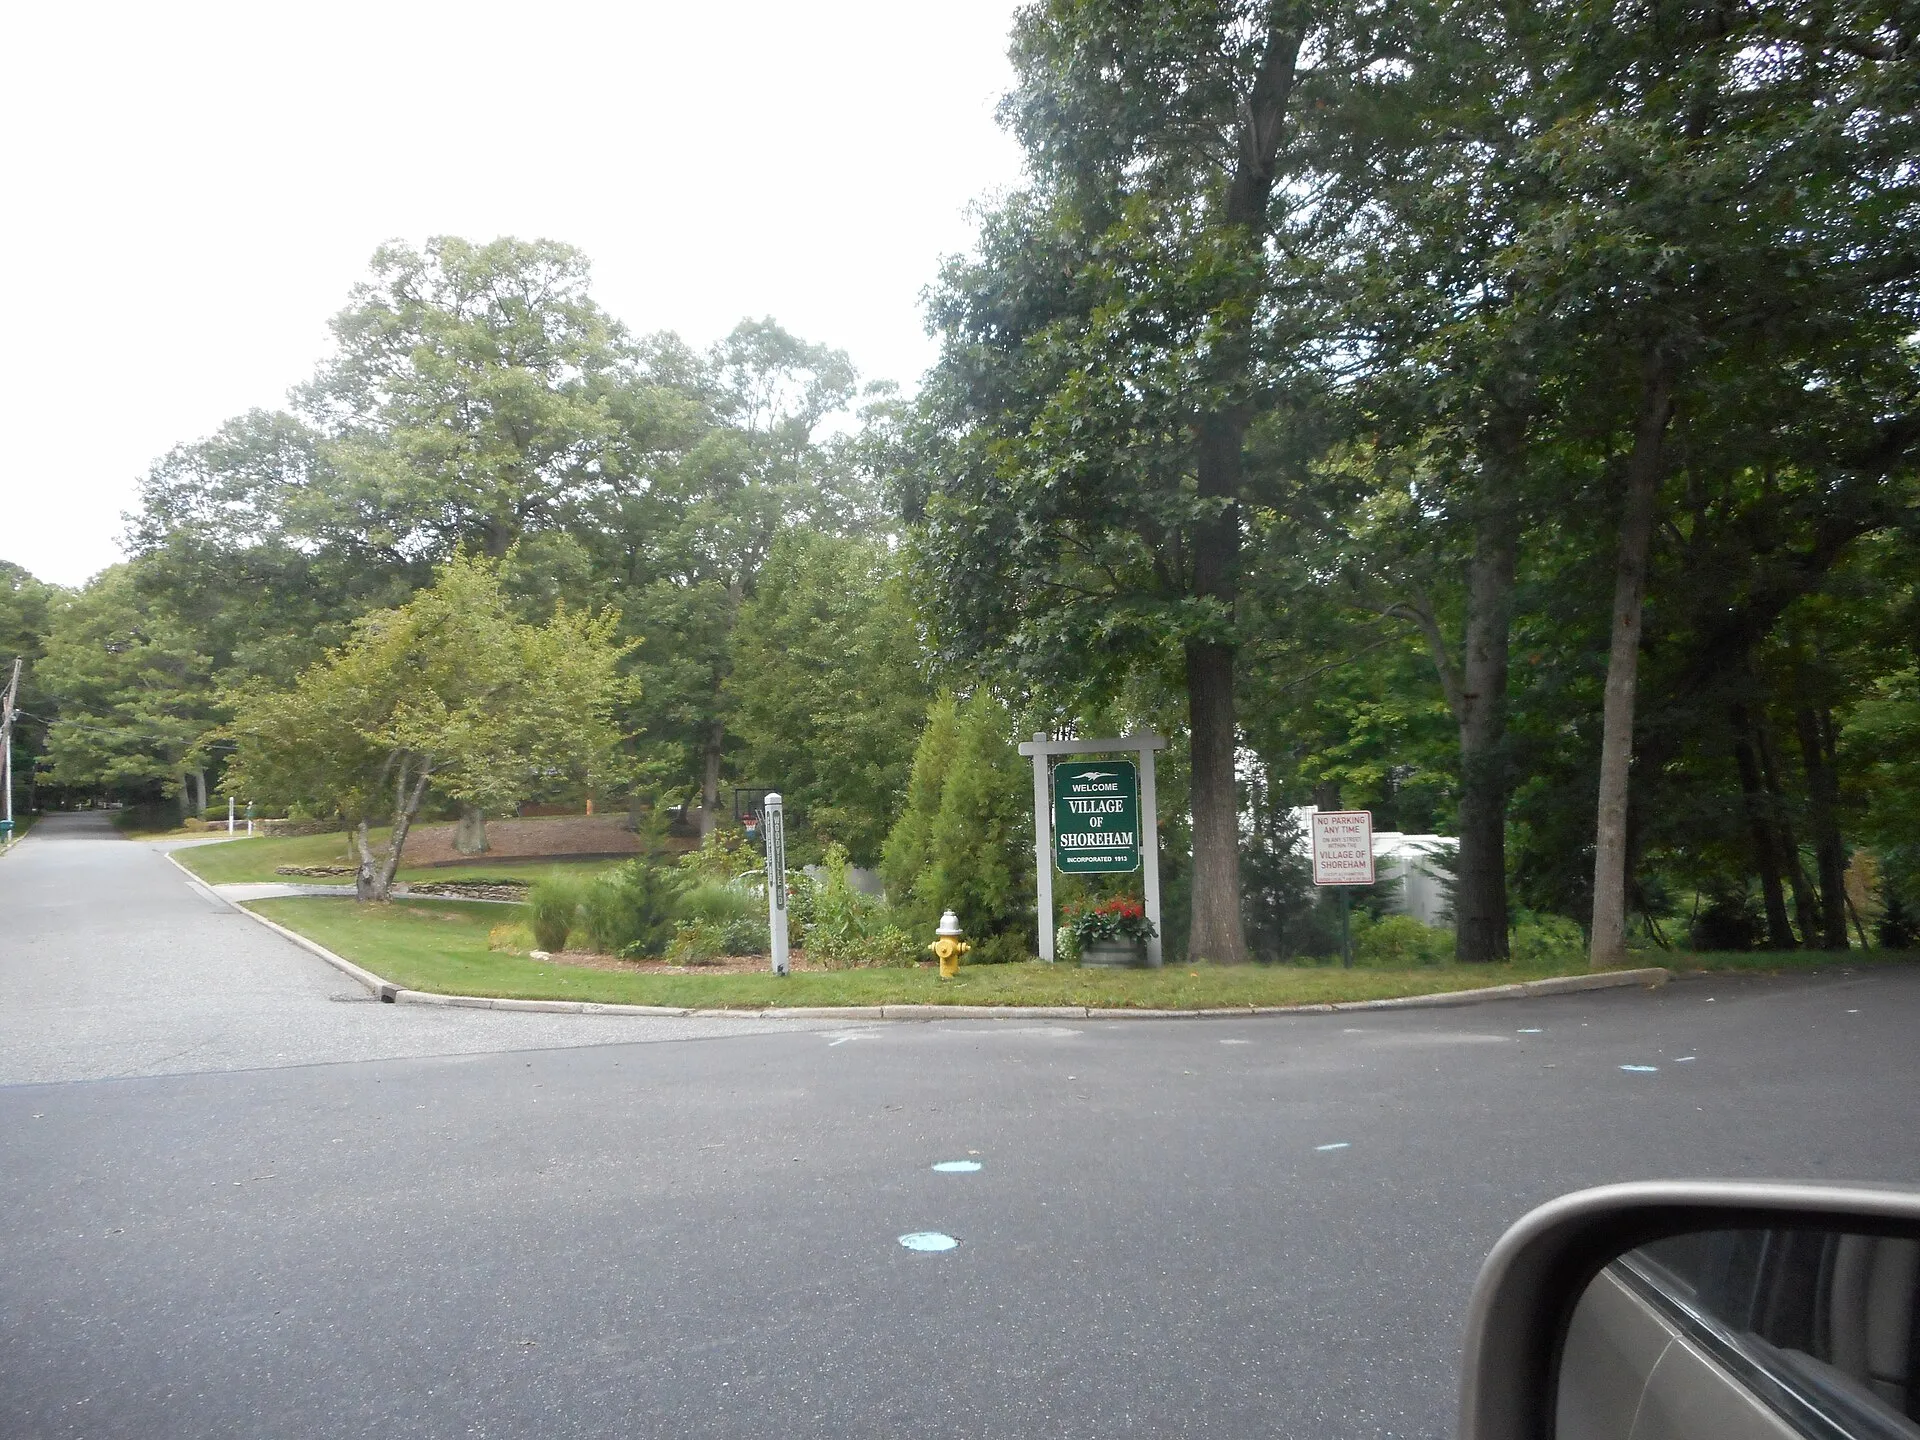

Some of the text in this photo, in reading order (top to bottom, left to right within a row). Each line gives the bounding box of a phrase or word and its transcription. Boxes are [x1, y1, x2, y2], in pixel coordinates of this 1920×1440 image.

[1072, 783, 1118, 792] WELCOME
[1069, 800, 1124, 813] VILLAGE
[1089, 816, 1104, 828] OF
[1317, 816, 1365, 825] NO PARKING
[1324, 825, 1360, 834] ANY TIME
[1060, 832, 1133, 847] SHOREHAM
[1319, 850, 1366, 859] VILLAGE OF
[774, 816, 783, 905] WOODVILLE RD
[1320, 860, 1366, 869] SHOREHAM
